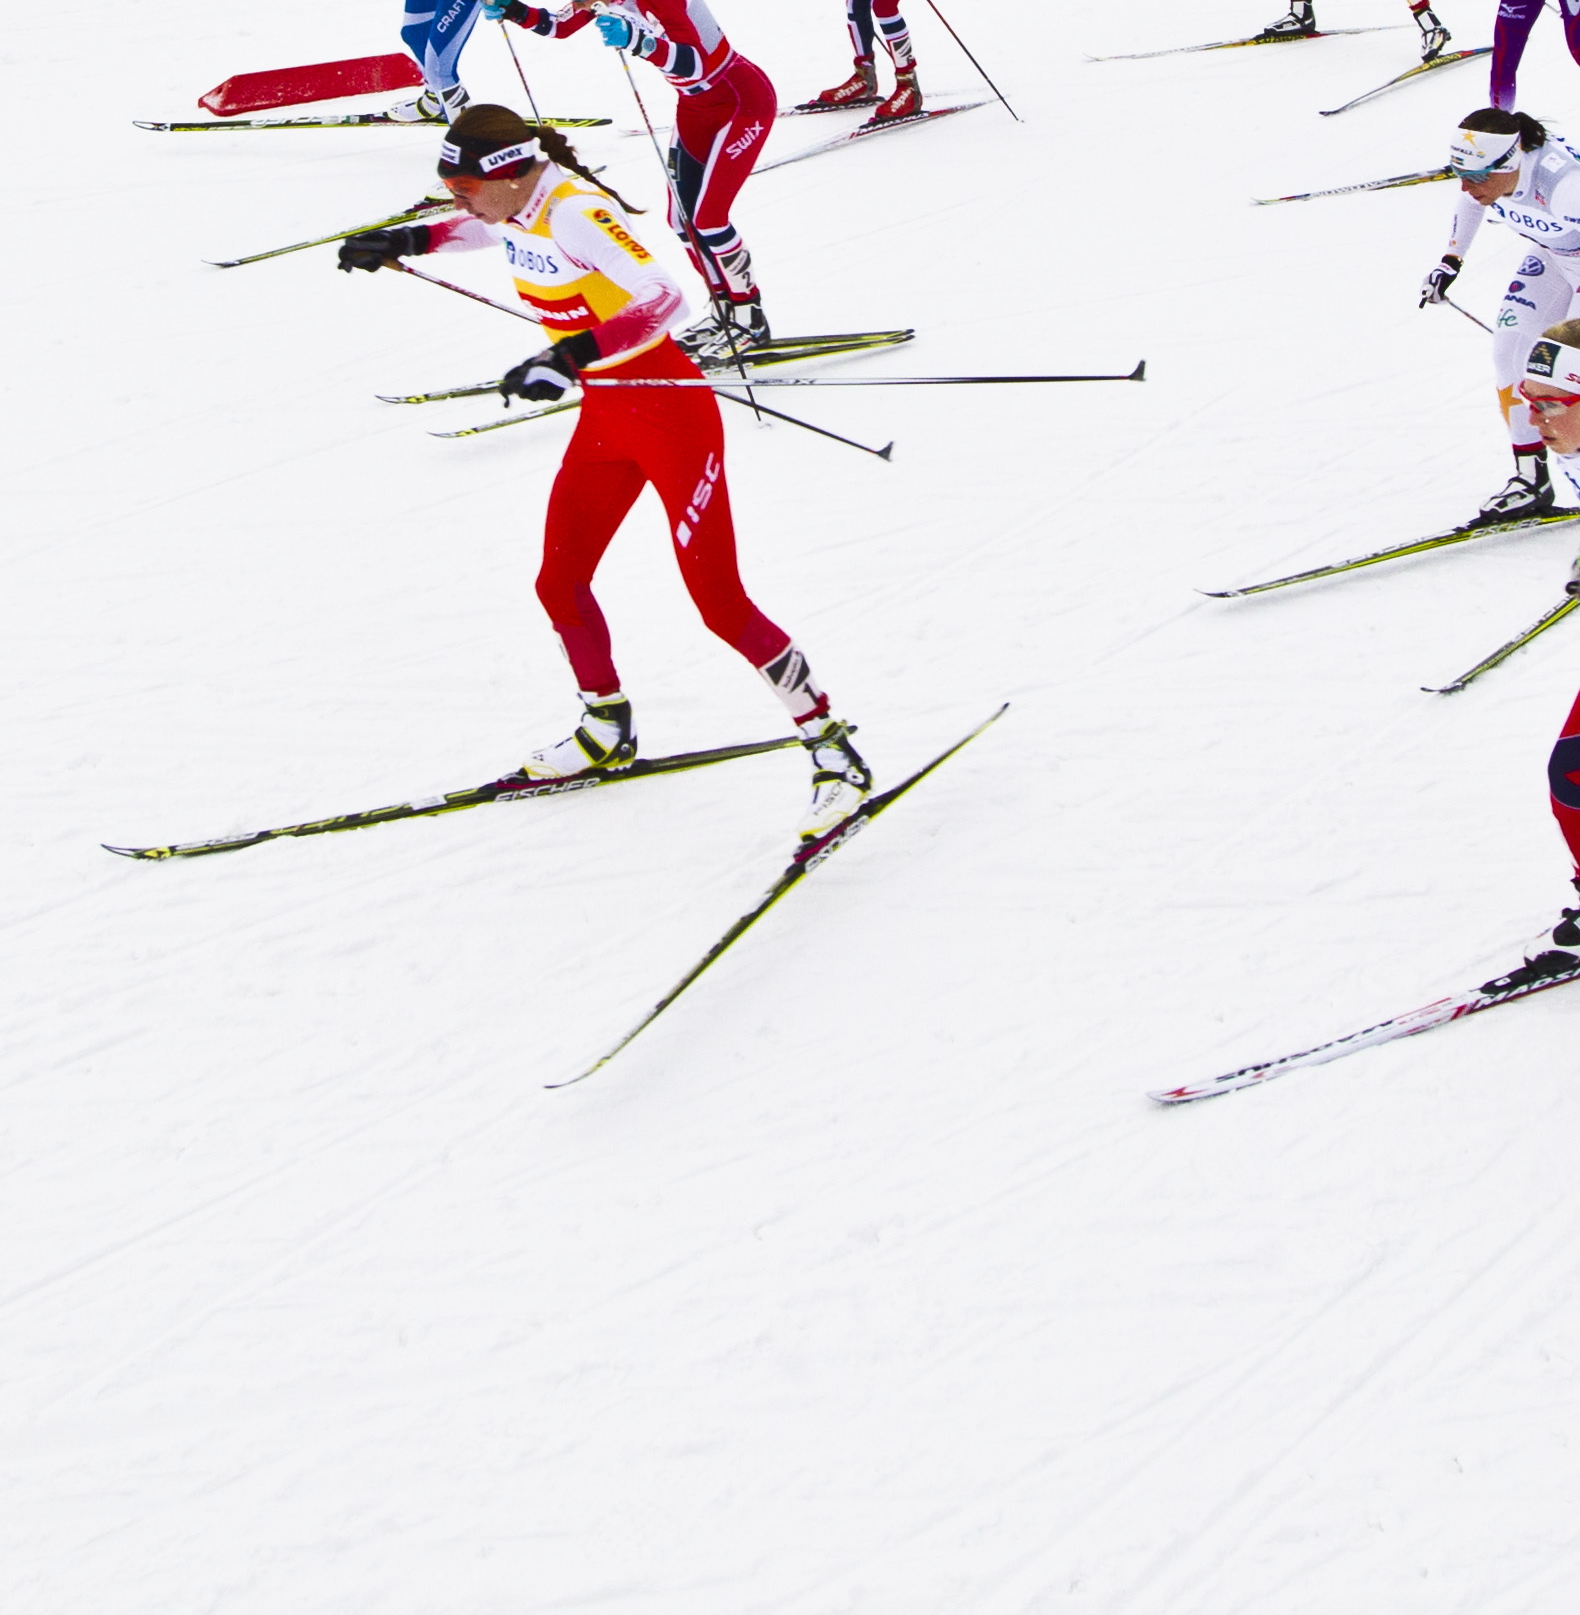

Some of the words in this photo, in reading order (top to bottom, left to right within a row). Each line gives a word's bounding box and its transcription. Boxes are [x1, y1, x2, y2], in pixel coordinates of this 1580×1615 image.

[488, 146, 524, 167] uvex
[1509, 210, 1563, 233] OBOS
[608, 223, 652, 260] LOTOS
[519, 249, 559, 275] OBOS
[741, 270, 755, 289] 2
[493, 776, 600, 804] FISCHER
